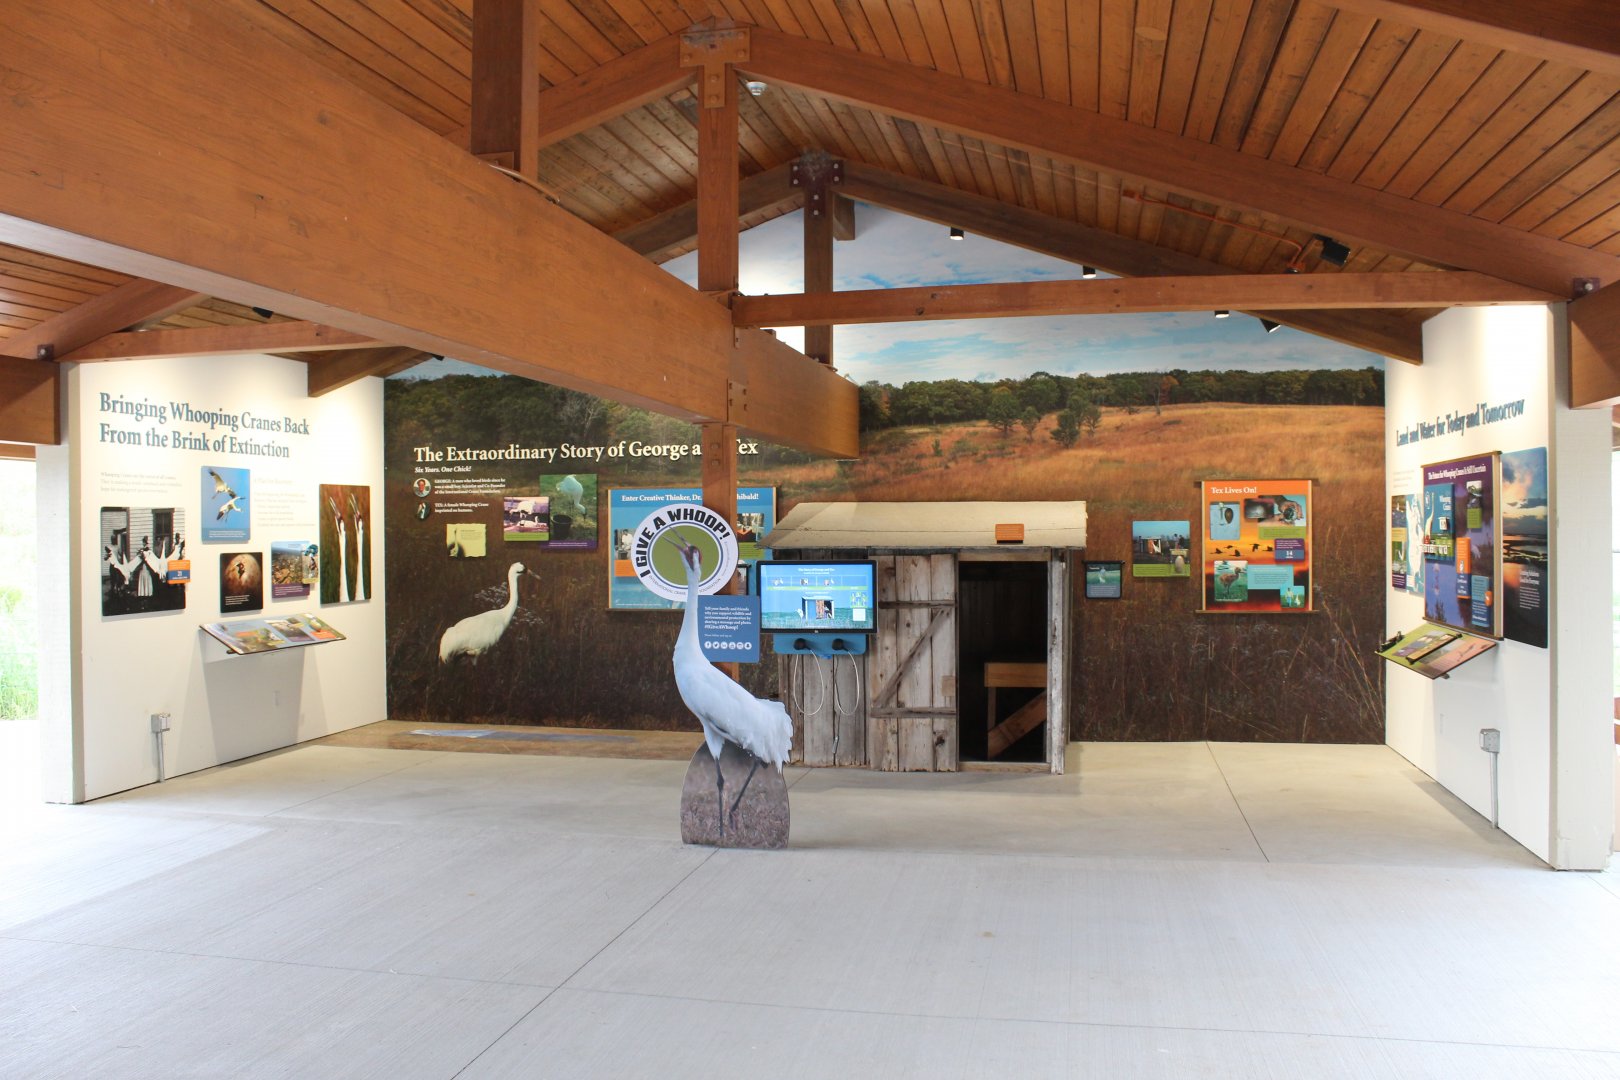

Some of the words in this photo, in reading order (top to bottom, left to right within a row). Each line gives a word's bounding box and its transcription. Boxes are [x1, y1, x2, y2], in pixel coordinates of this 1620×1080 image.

[99, 392, 167, 424] Bringing
[169, 401, 239, 432] Whooping
[241, 411, 281, 432] Cranes
[284, 416, 310, 435] Back
[1396, 426, 1408, 447] Land
[1409, 423, 1419, 443] and
[1420, 422, 1435, 440] Water
[1436, 416, 1445, 436] for
[1446, 410, 1466, 436] Today
[1466, 404, 1480, 428] and
[1481, 399, 1525, 425] Tomorrow
[99, 422, 142, 445] From
[145, 427, 169, 448] the
[172, 430, 211, 451] Brink
[213, 434, 228, 453] of
[229, 436, 289, 458] Extinction
[413, 446, 444, 463] The
[446, 444, 557, 464] Extraordinary
[560, 443, 605, 463] Story
[607, 441, 627, 457] of
[628, 441, 689, 461] George
[414, 466, 424, 474] Six
[621, 494, 638, 502] Enter
[639, 494, 664, 502] Creative
[665, 493, 691, 502] Thinker,
[1225, 486, 1242, 494] Lives
[1243, 486, 1257, 494] On!
[652, 516, 667, 530] A
[667, 508, 730, 540] WHOOP!
[635, 527, 655, 568] GIVE
[640, 569, 651, 578] I
